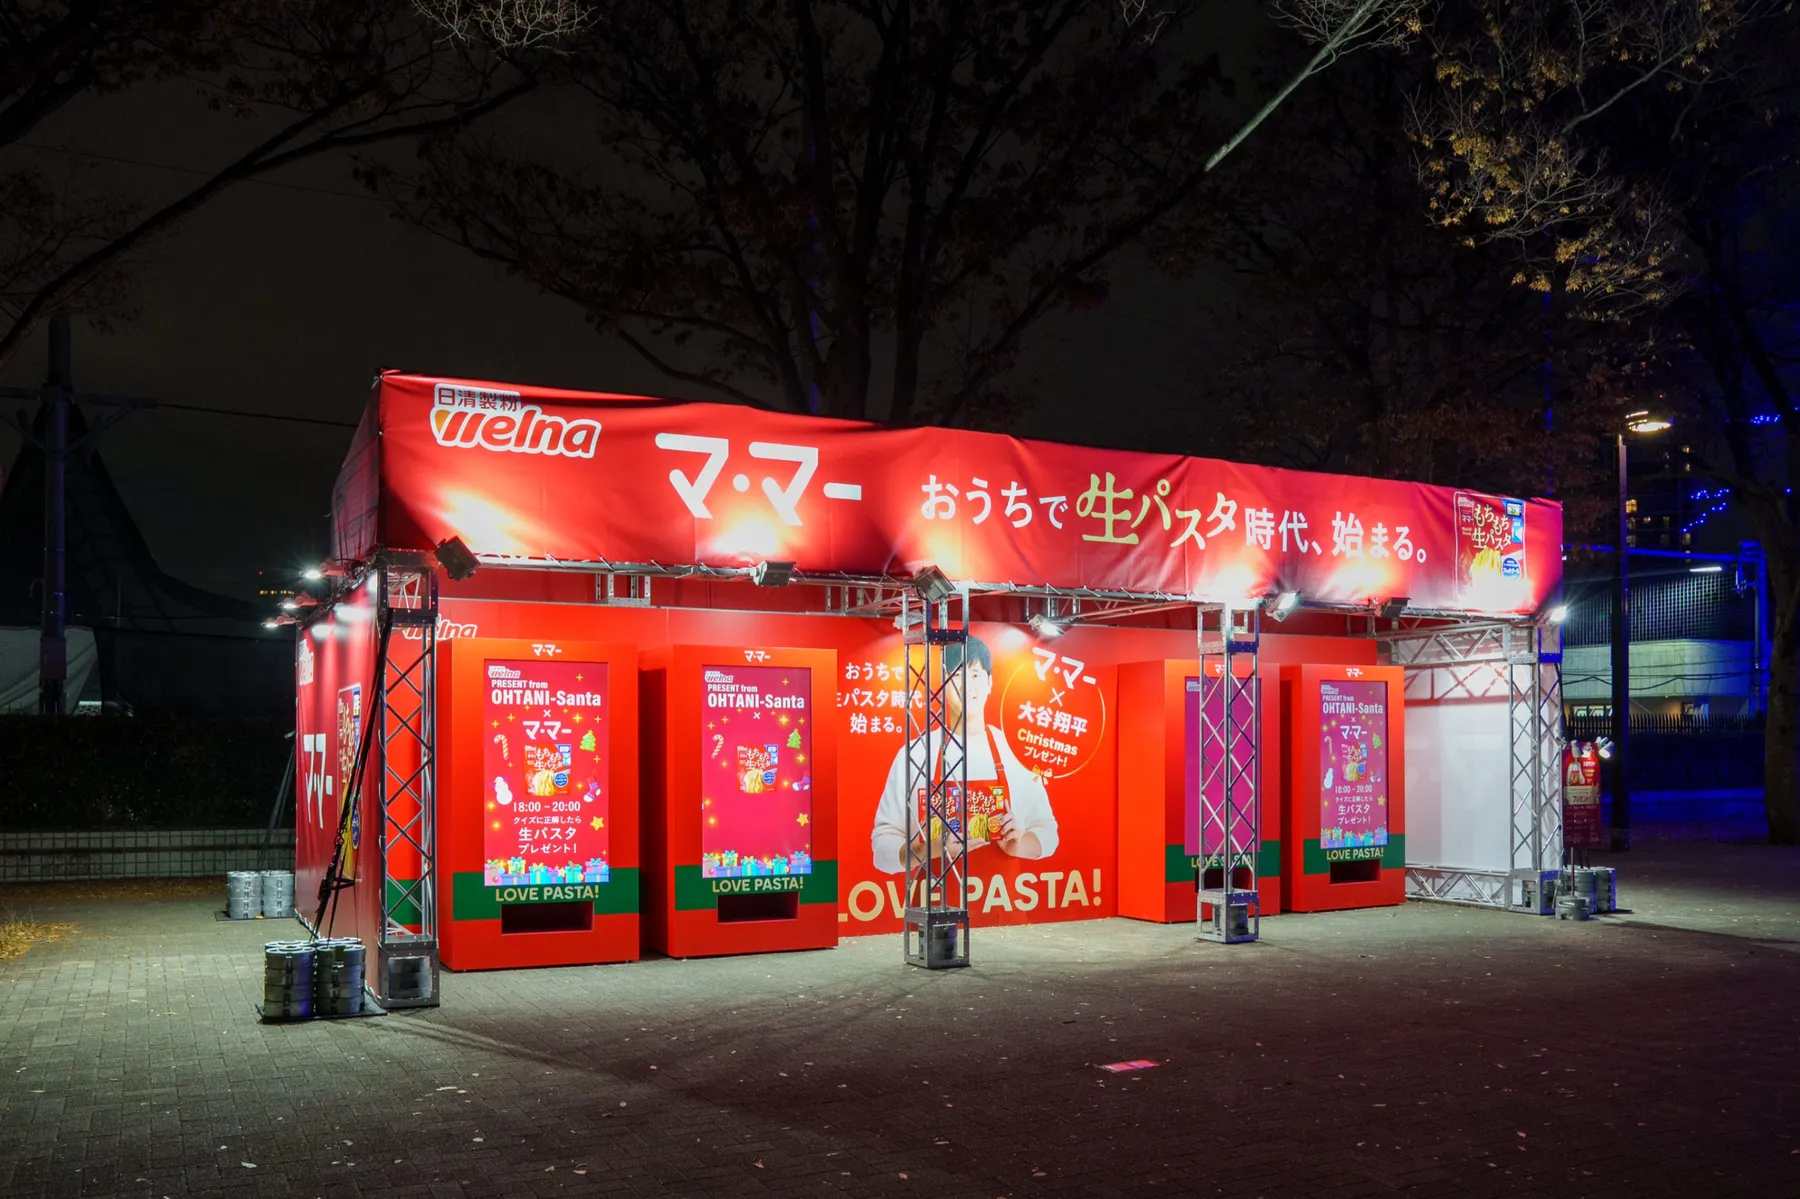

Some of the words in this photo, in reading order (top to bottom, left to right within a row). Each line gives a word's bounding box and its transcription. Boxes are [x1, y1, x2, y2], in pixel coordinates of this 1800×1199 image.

[438, 387, 519, 412] 日清製粉
[491, 679, 527, 689] PRESENT
[528, 680, 548, 689] from
[707, 684, 739, 692] PRESENT
[741, 684, 758, 692] from
[491, 689, 601, 707] OHTANI-Santa
[707, 692, 805, 708] OHTANI-Santa
[1322, 702, 1383, 714] OHTANI-Santa
[850, 712, 903, 735] 始まる。
[1017, 701, 1088, 738] 大谷翔平
[1017, 728, 1078, 756] Christmas
[1024, 745, 1068, 767] プレゼント!
[1335, 785, 1350, 793] 18:00
[1356, 784, 1372, 793] 20:00
[513, 801, 541, 812] 18:00
[552, 801, 580, 812] 20:00
[1338, 804, 1370, 815] 生パスタ
[518, 826, 577, 841] 生パスタ
[1326, 849, 1351, 860] LOVE
[1353, 847, 1384, 859] PASTA!
[712, 878, 750, 893] LOVE
[754, 876, 804, 891] PASTA!
[959, 868, 1102, 914] PASTA!
[495, 887, 539, 902] LOVE
[543, 885, 599, 900] PASTA!
